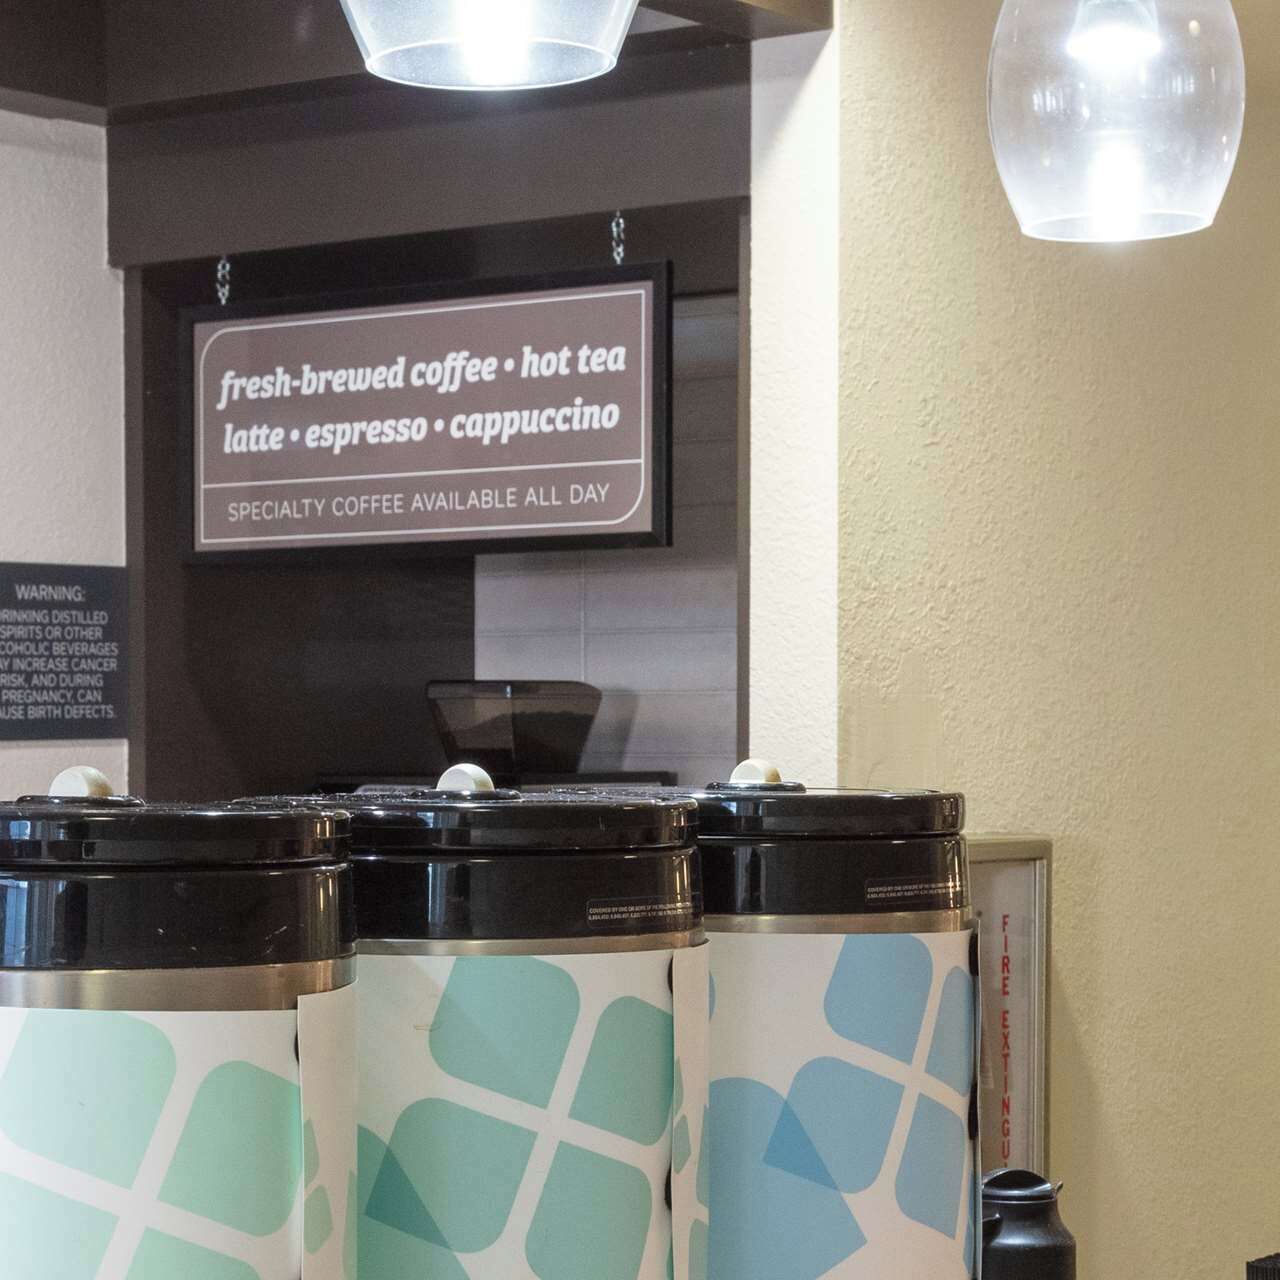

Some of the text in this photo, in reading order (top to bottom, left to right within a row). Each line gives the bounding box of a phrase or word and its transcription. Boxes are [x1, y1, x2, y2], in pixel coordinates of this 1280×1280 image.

[217, 344, 626, 410] fresh-brewed coffee hot tea
[224, 397, 620, 454] latte espresso cappuccino
[228, 482, 610, 522] SPECIALTY COFFEE AVAILABLE ALL DAY
[15, 584, 86, 602] WARNING:
[52, 610, 108, 625] DISTILLED
[0, 624, 103, 640] SPIRITS OR OTHER
[52, 642, 119, 656] BEVERAGES
[13, 657, 68, 671] INCREASE
[71, 658, 117, 672] CANCER
[0, 673, 104, 688] RISK, AND DURING
[2, 689, 102, 704] PREGNANCY, CAN
[27, 705, 62, 720] BIRTH
[1001, 914, 1010, 1168] FIRE EXTINGU
